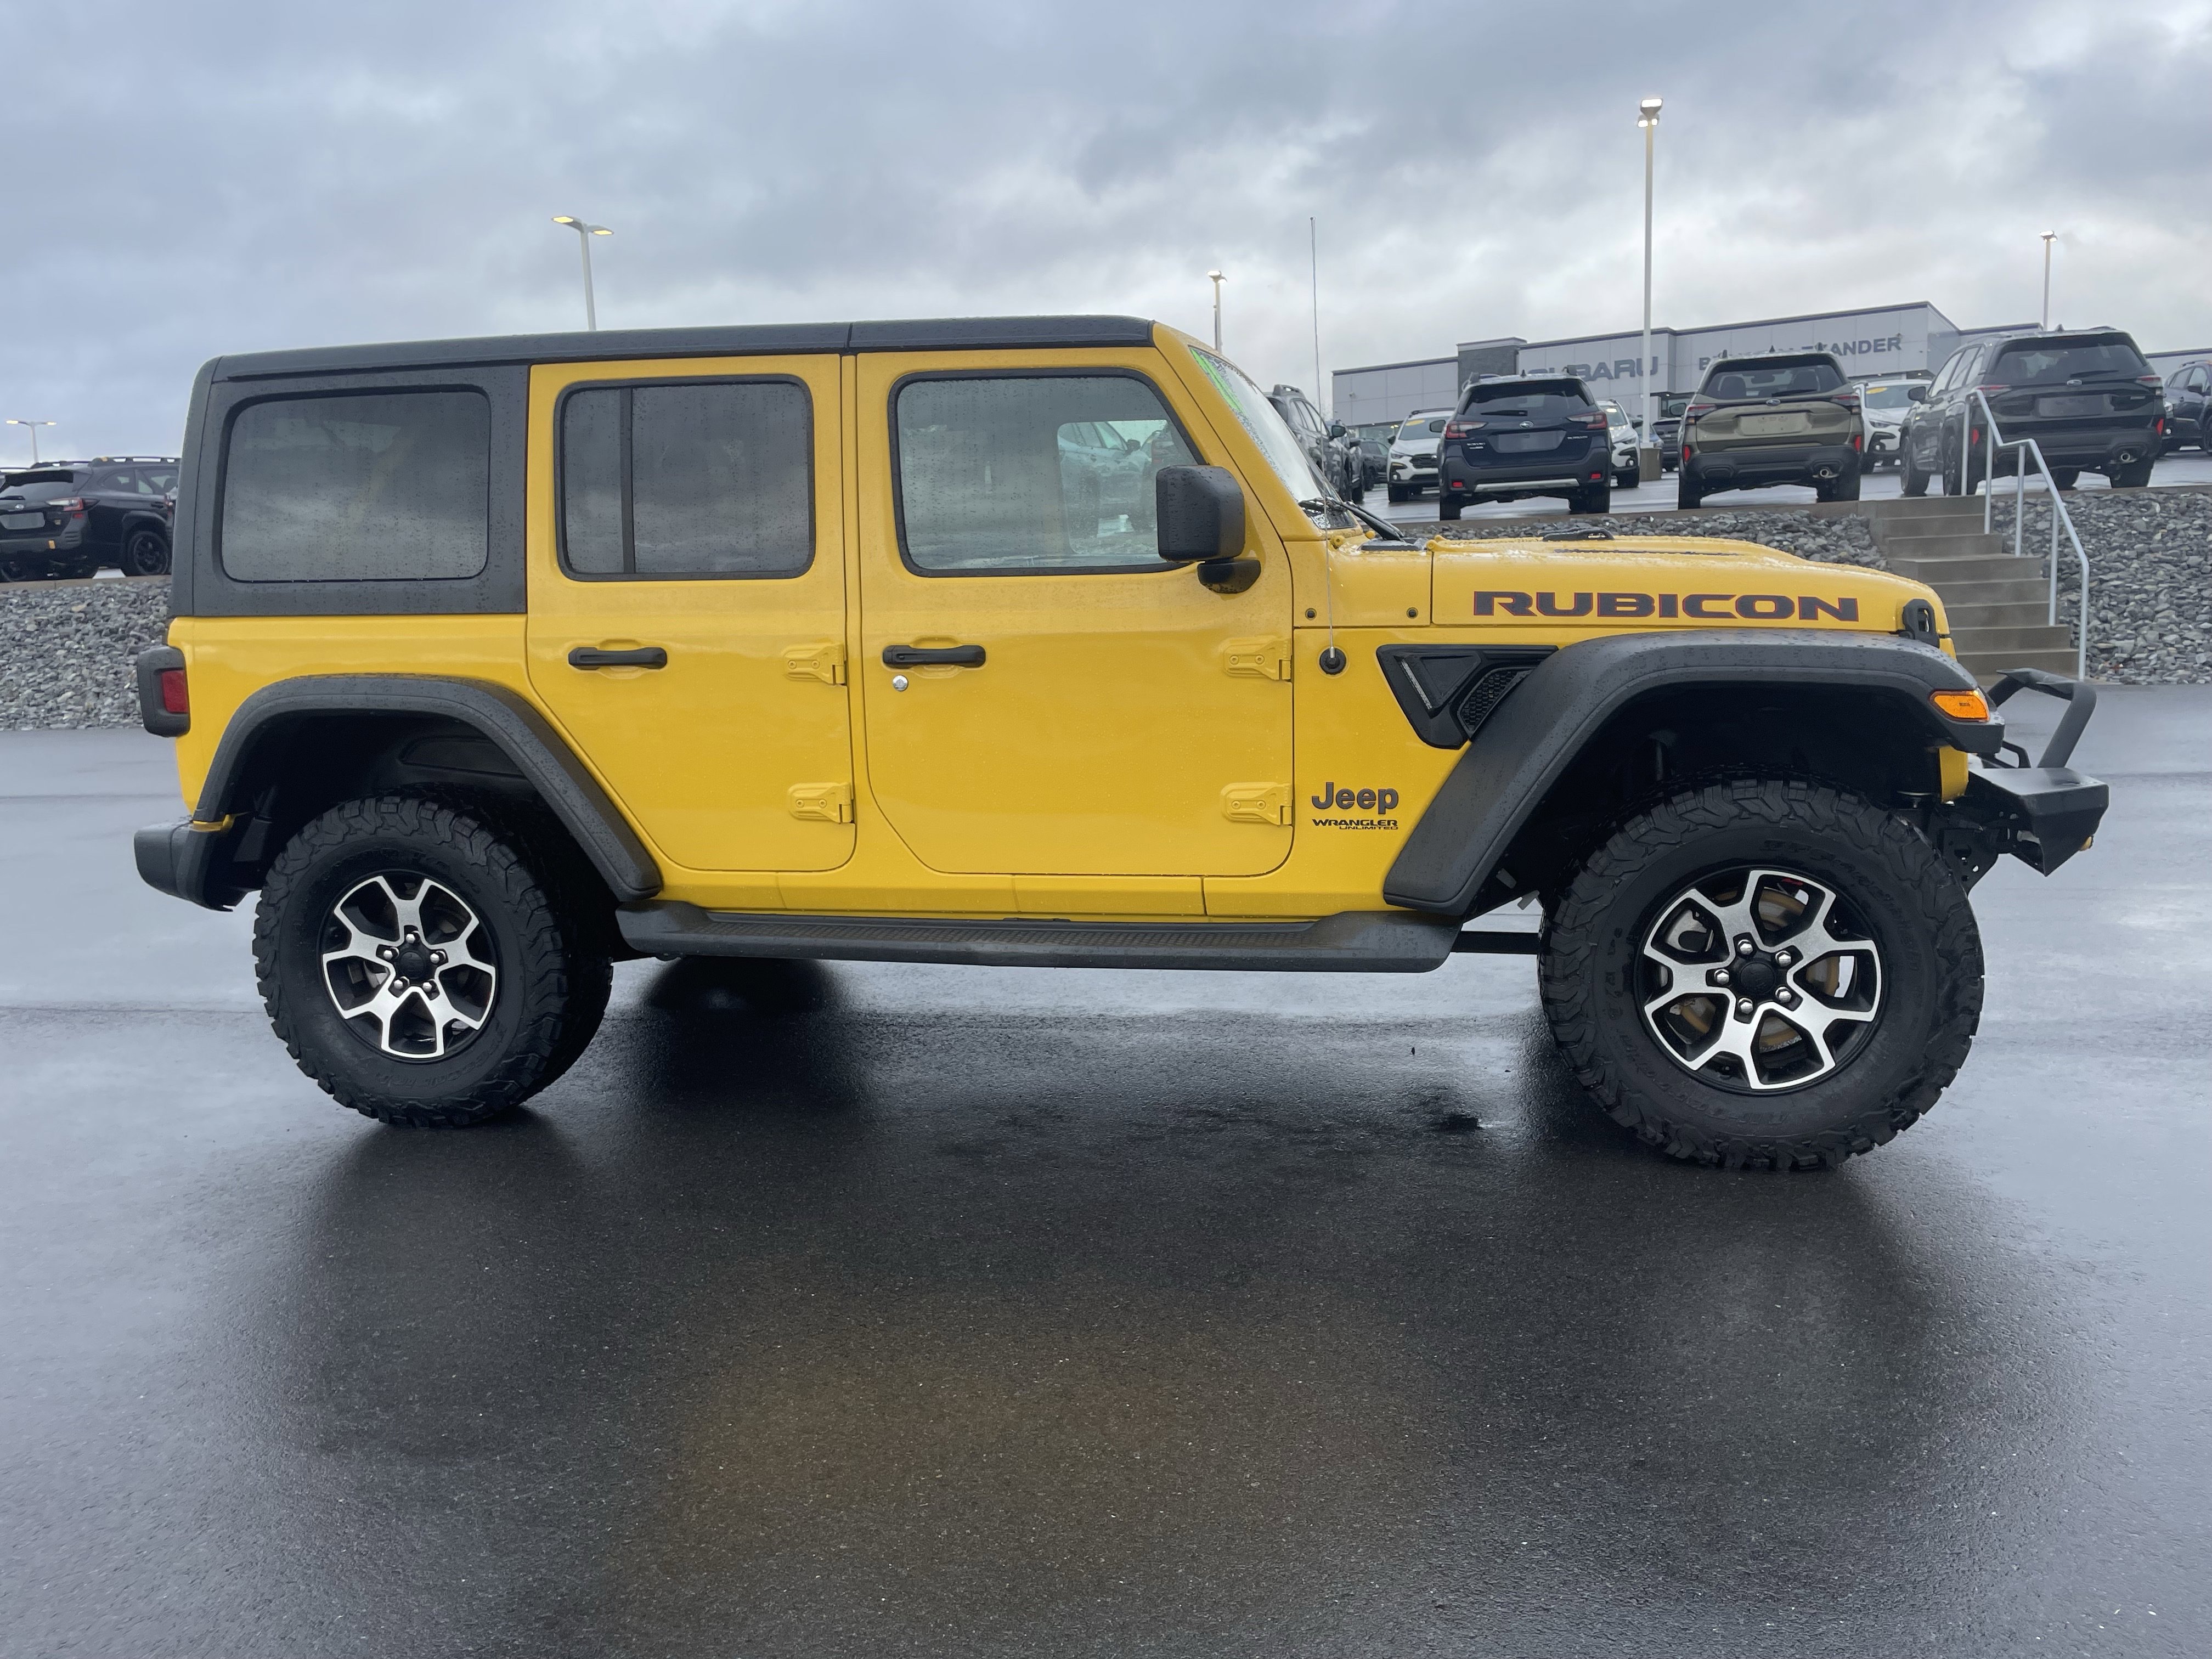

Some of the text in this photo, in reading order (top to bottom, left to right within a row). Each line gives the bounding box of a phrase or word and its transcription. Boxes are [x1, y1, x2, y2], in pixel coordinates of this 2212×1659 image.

[1528, 356, 1658, 382] BARU
[1474, 590, 1859, 622] RUBICON
[1311, 781, 1399, 815] Jeep
